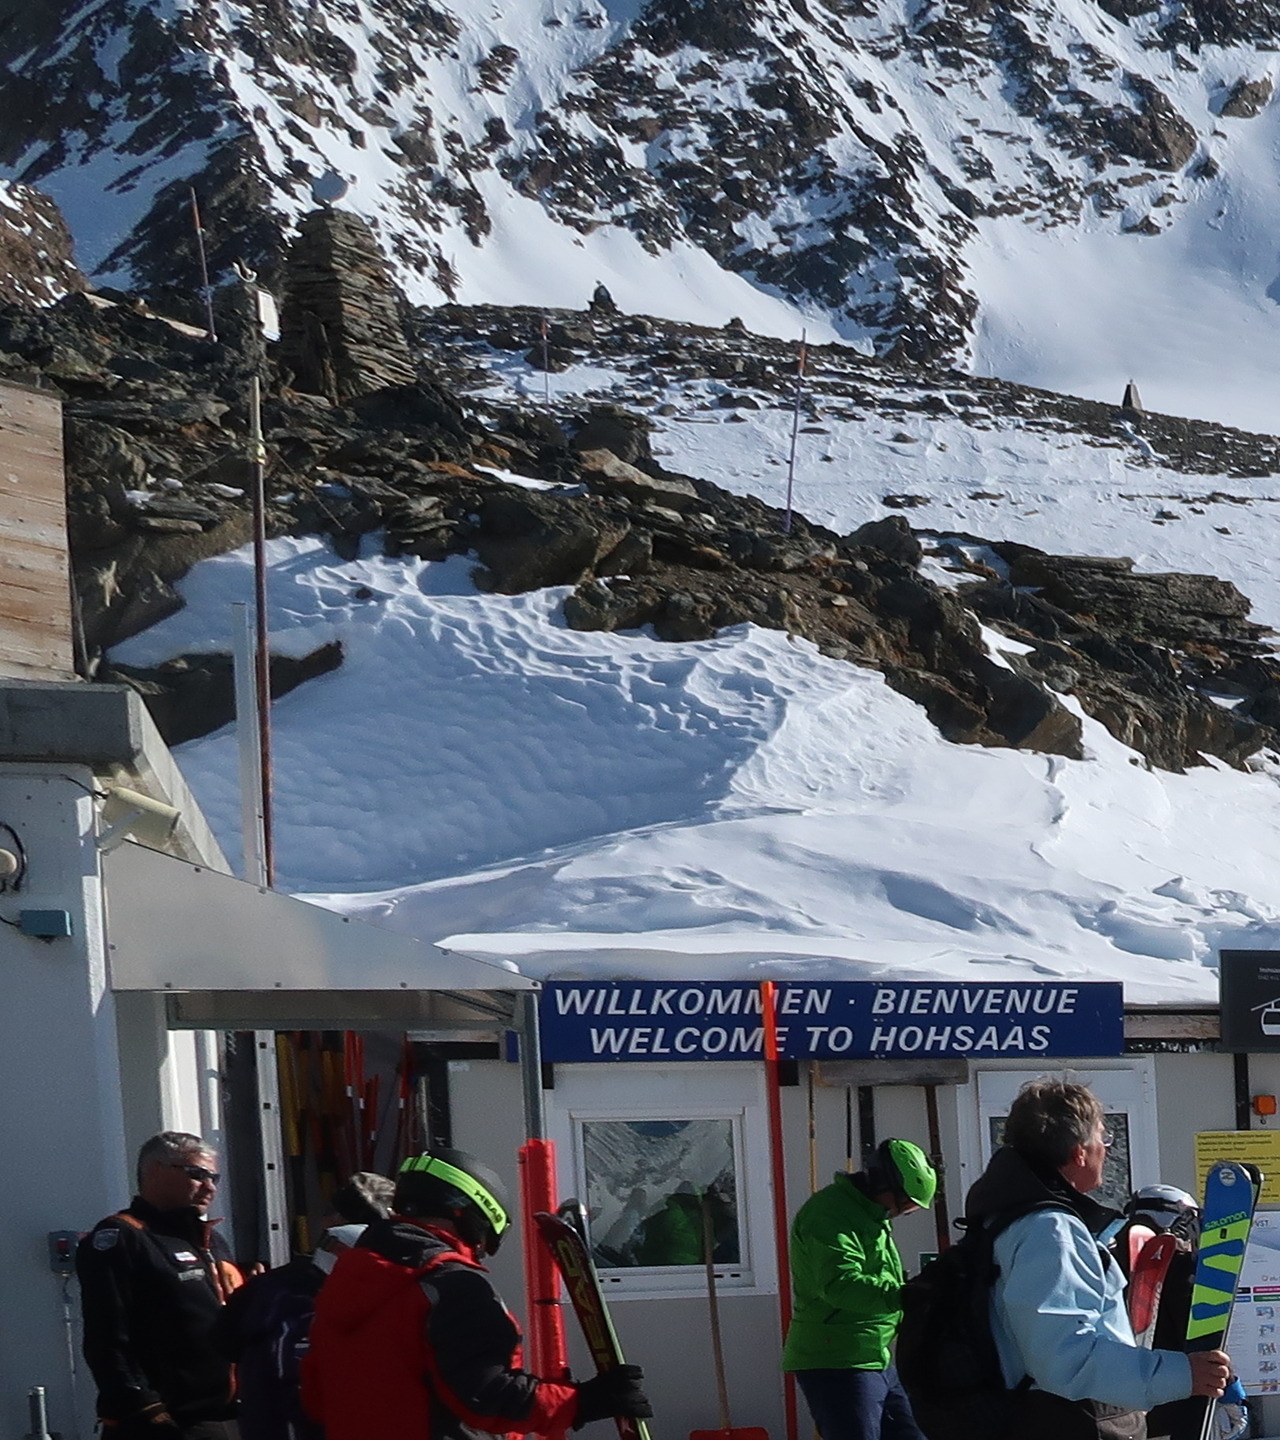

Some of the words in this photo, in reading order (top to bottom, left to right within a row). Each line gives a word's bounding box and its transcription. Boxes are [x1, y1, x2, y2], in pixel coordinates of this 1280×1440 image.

[555, 988, 831, 1015] WILLKOMMEN
[871, 988, 1079, 1015] BIENVENUE
[589, 1026, 790, 1054] WELCOME
[806, 1026, 853, 1053] TO
[869, 1025, 1052, 1052] HOHSAAS
[474, 1190, 504, 1224] HEAD
